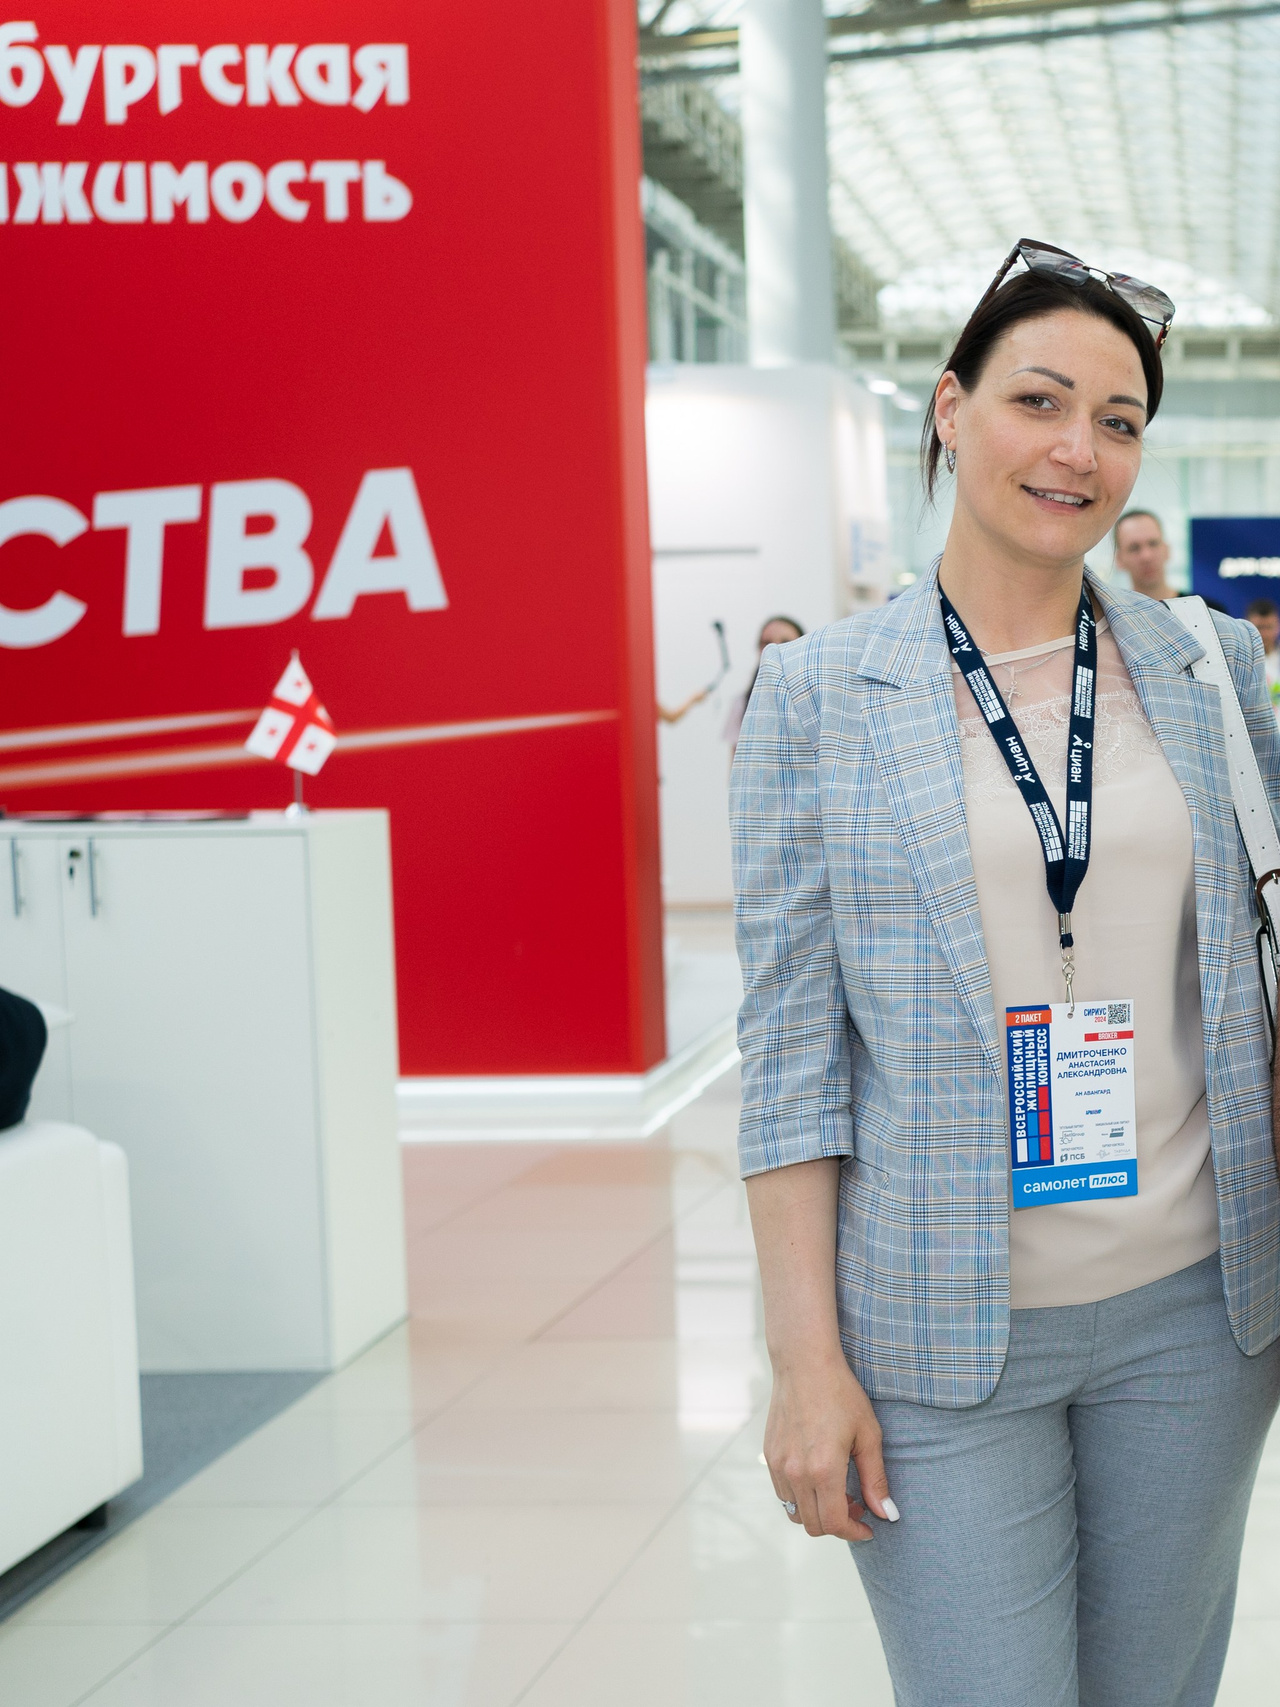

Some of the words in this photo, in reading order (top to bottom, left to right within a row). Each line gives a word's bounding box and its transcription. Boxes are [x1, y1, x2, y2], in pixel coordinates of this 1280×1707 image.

[0, 21, 410, 125] бургская
[0, 466, 449, 649] СТВА
[1015, 1014, 1020, 1023] 2
[1021, 1012, 1042, 1023] ПАКЕТ
[1084, 1007, 1107, 1016] СИРИУС
[1036, 1028, 1048, 1085] КОНГРЕСС
[1056, 1047, 1127, 1061] ДМИТРОЧЕНКО
[1068, 1058, 1116, 1069] АНАСТАСИЯ
[1022, 1028, 1037, 1111] ЖИЛИЩНЫЙ
[1057, 1067, 1127, 1079] АЛЕКСАНДРОВНА
[1010, 1029, 1026, 1137] ВСЕРОССИЙСКИЙ
[1023, 1177, 1087, 1194] самолет
[1092, 1174, 1125, 1186] плюс
